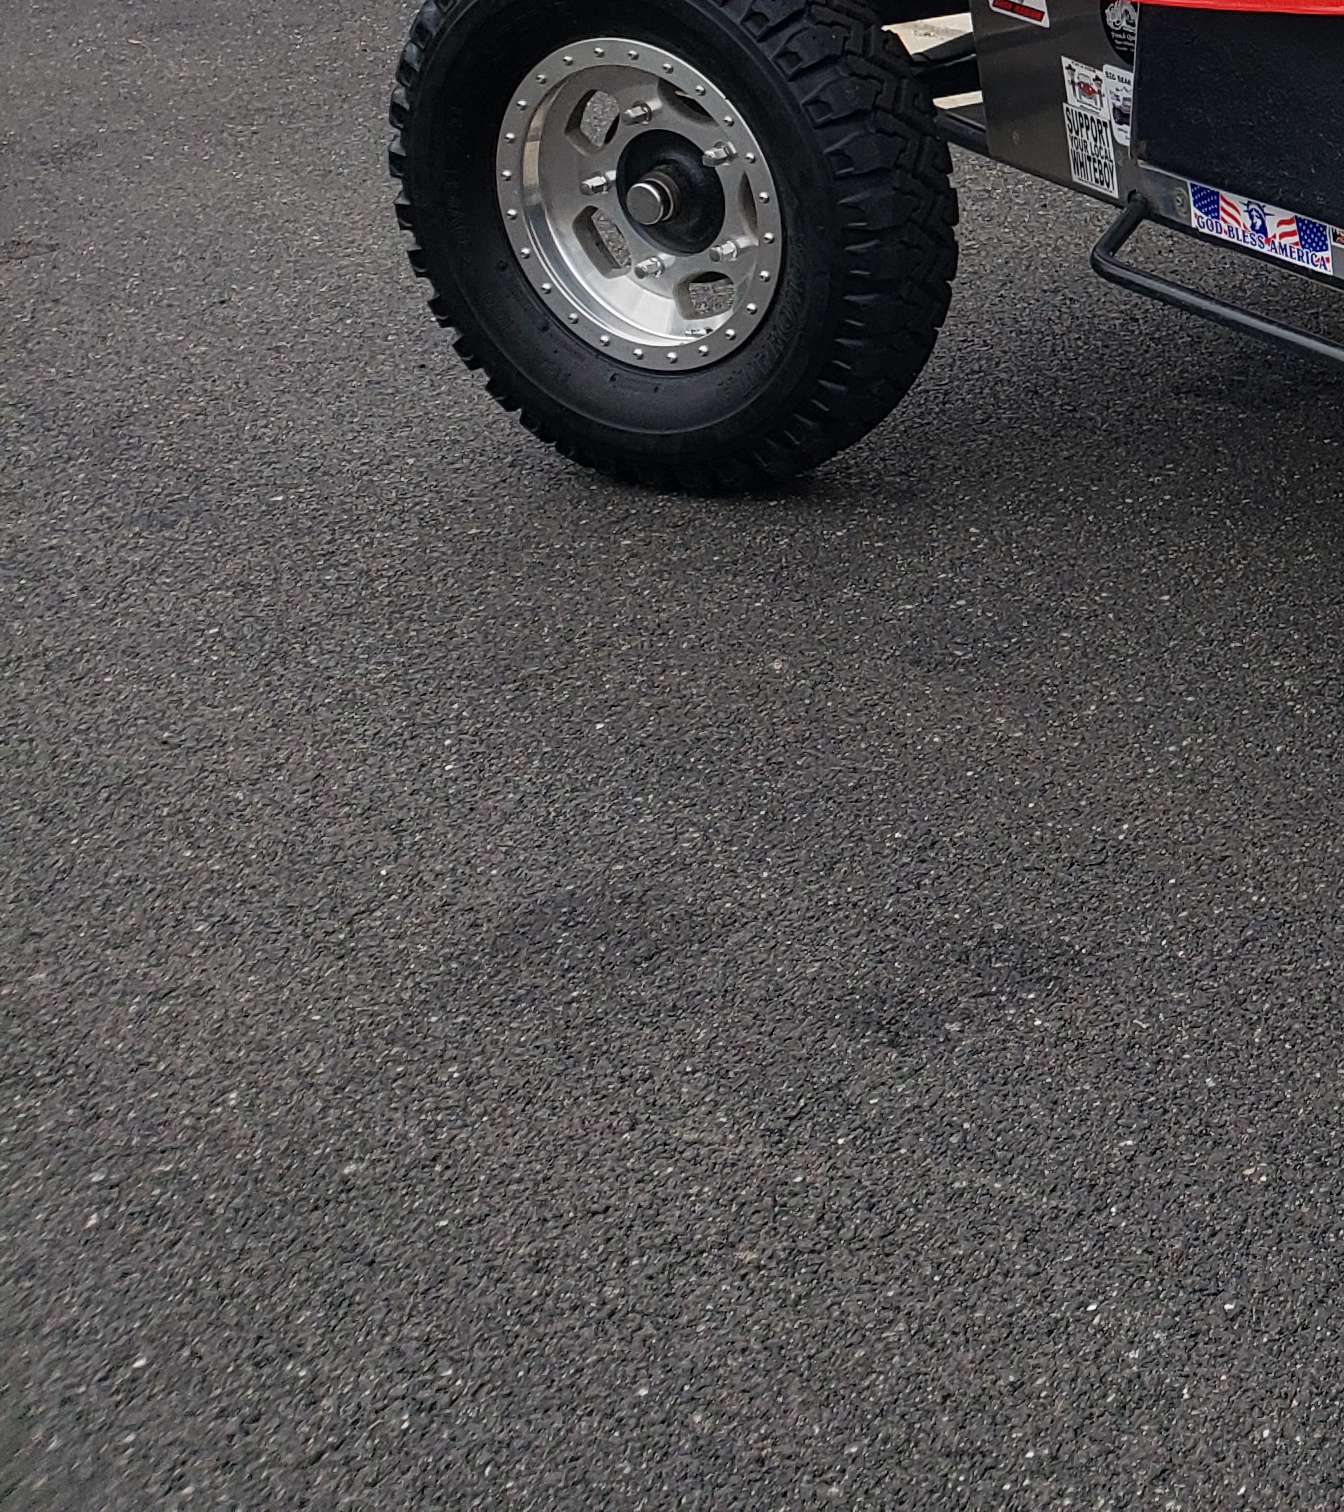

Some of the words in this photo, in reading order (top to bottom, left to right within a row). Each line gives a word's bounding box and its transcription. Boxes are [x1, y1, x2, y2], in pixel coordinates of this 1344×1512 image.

[1066, 107, 1110, 148] SUPPORT
[1069, 135, 1088, 155] YOUR
[1090, 141, 1113, 164] LOCAL
[1070, 148, 1115, 191] WHITEBOY
[1196, 215, 1223, 235] GOD
[1227, 226, 1266, 250] BLESS
[1267, 239, 1328, 271] AMERICA
